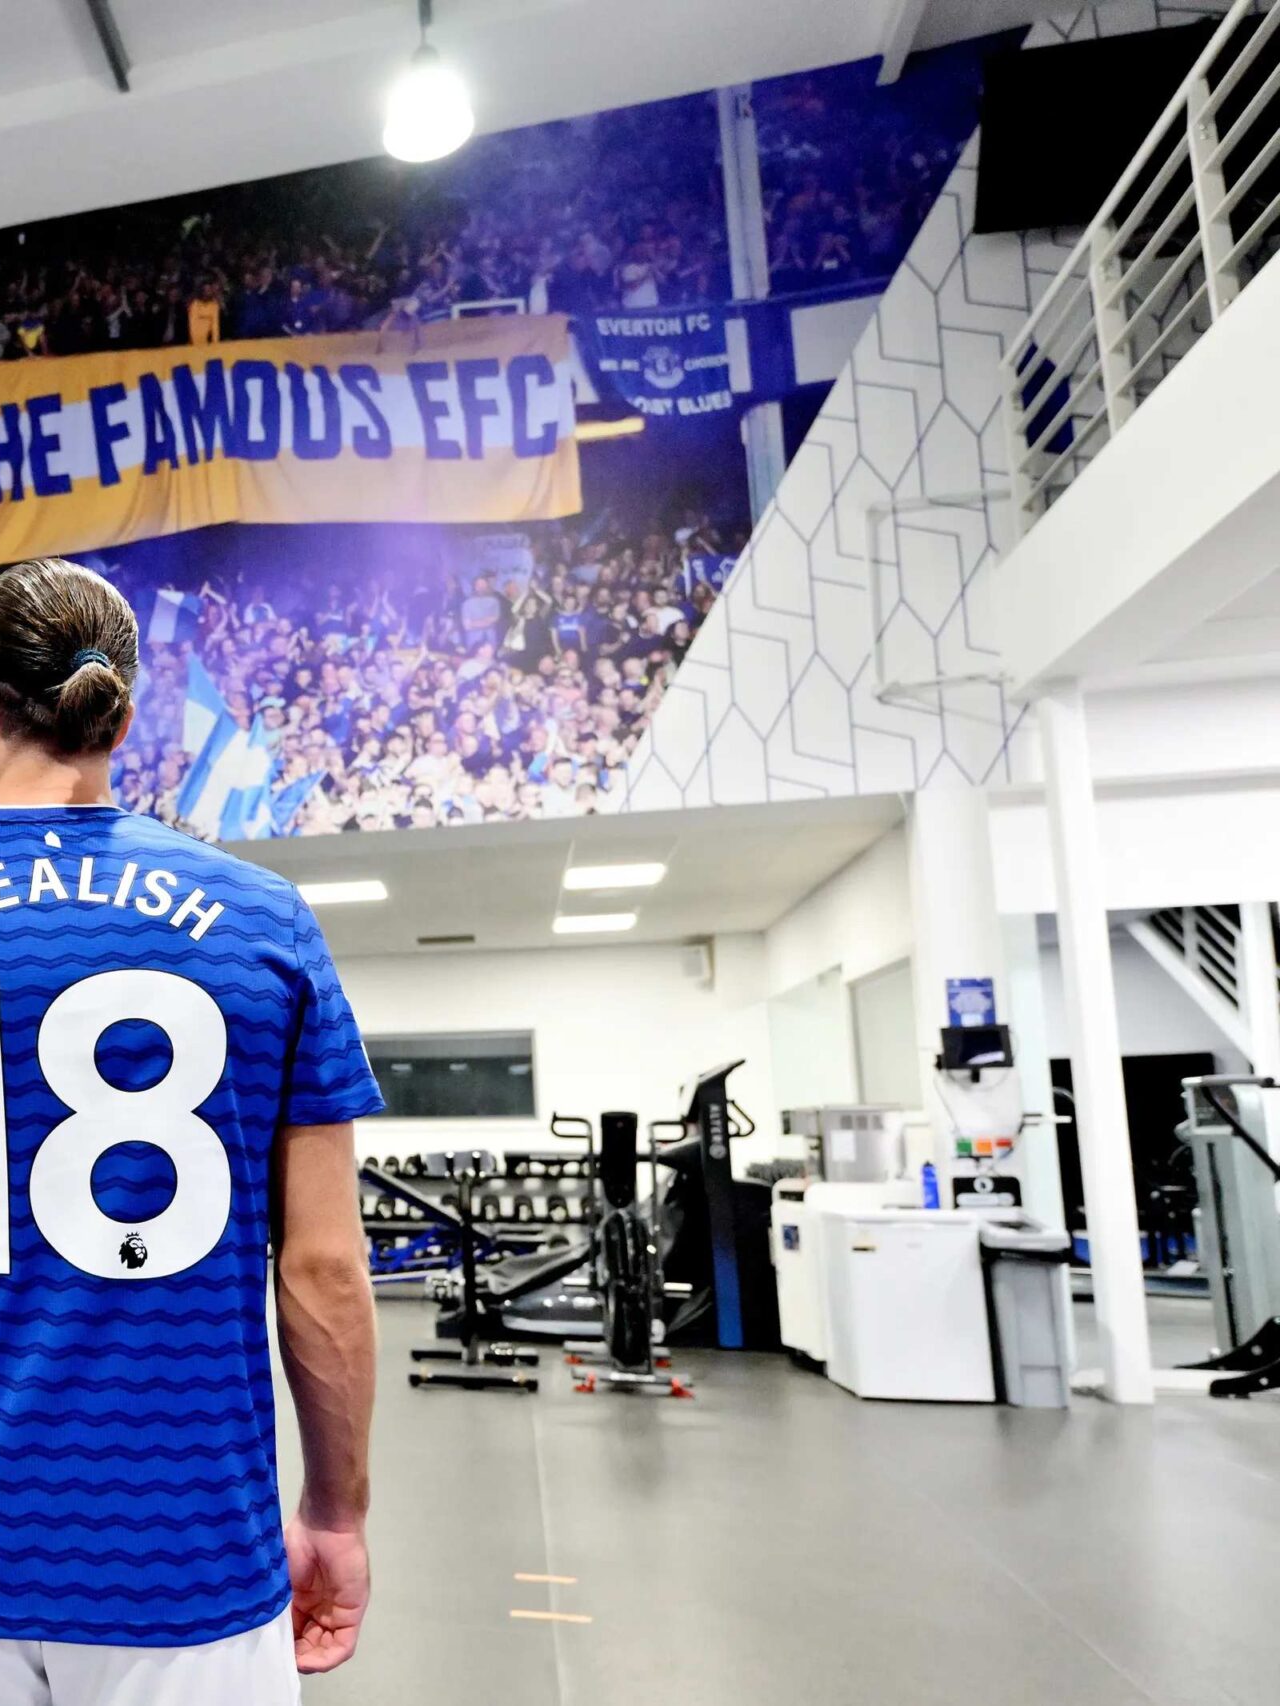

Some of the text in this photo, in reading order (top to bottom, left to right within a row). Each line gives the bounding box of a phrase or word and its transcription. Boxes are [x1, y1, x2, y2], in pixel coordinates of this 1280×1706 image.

[596, 312, 711, 336] EVERTON FC
[89, 358, 391, 487] FAMOUS
[407, 354, 558, 459] EFC
